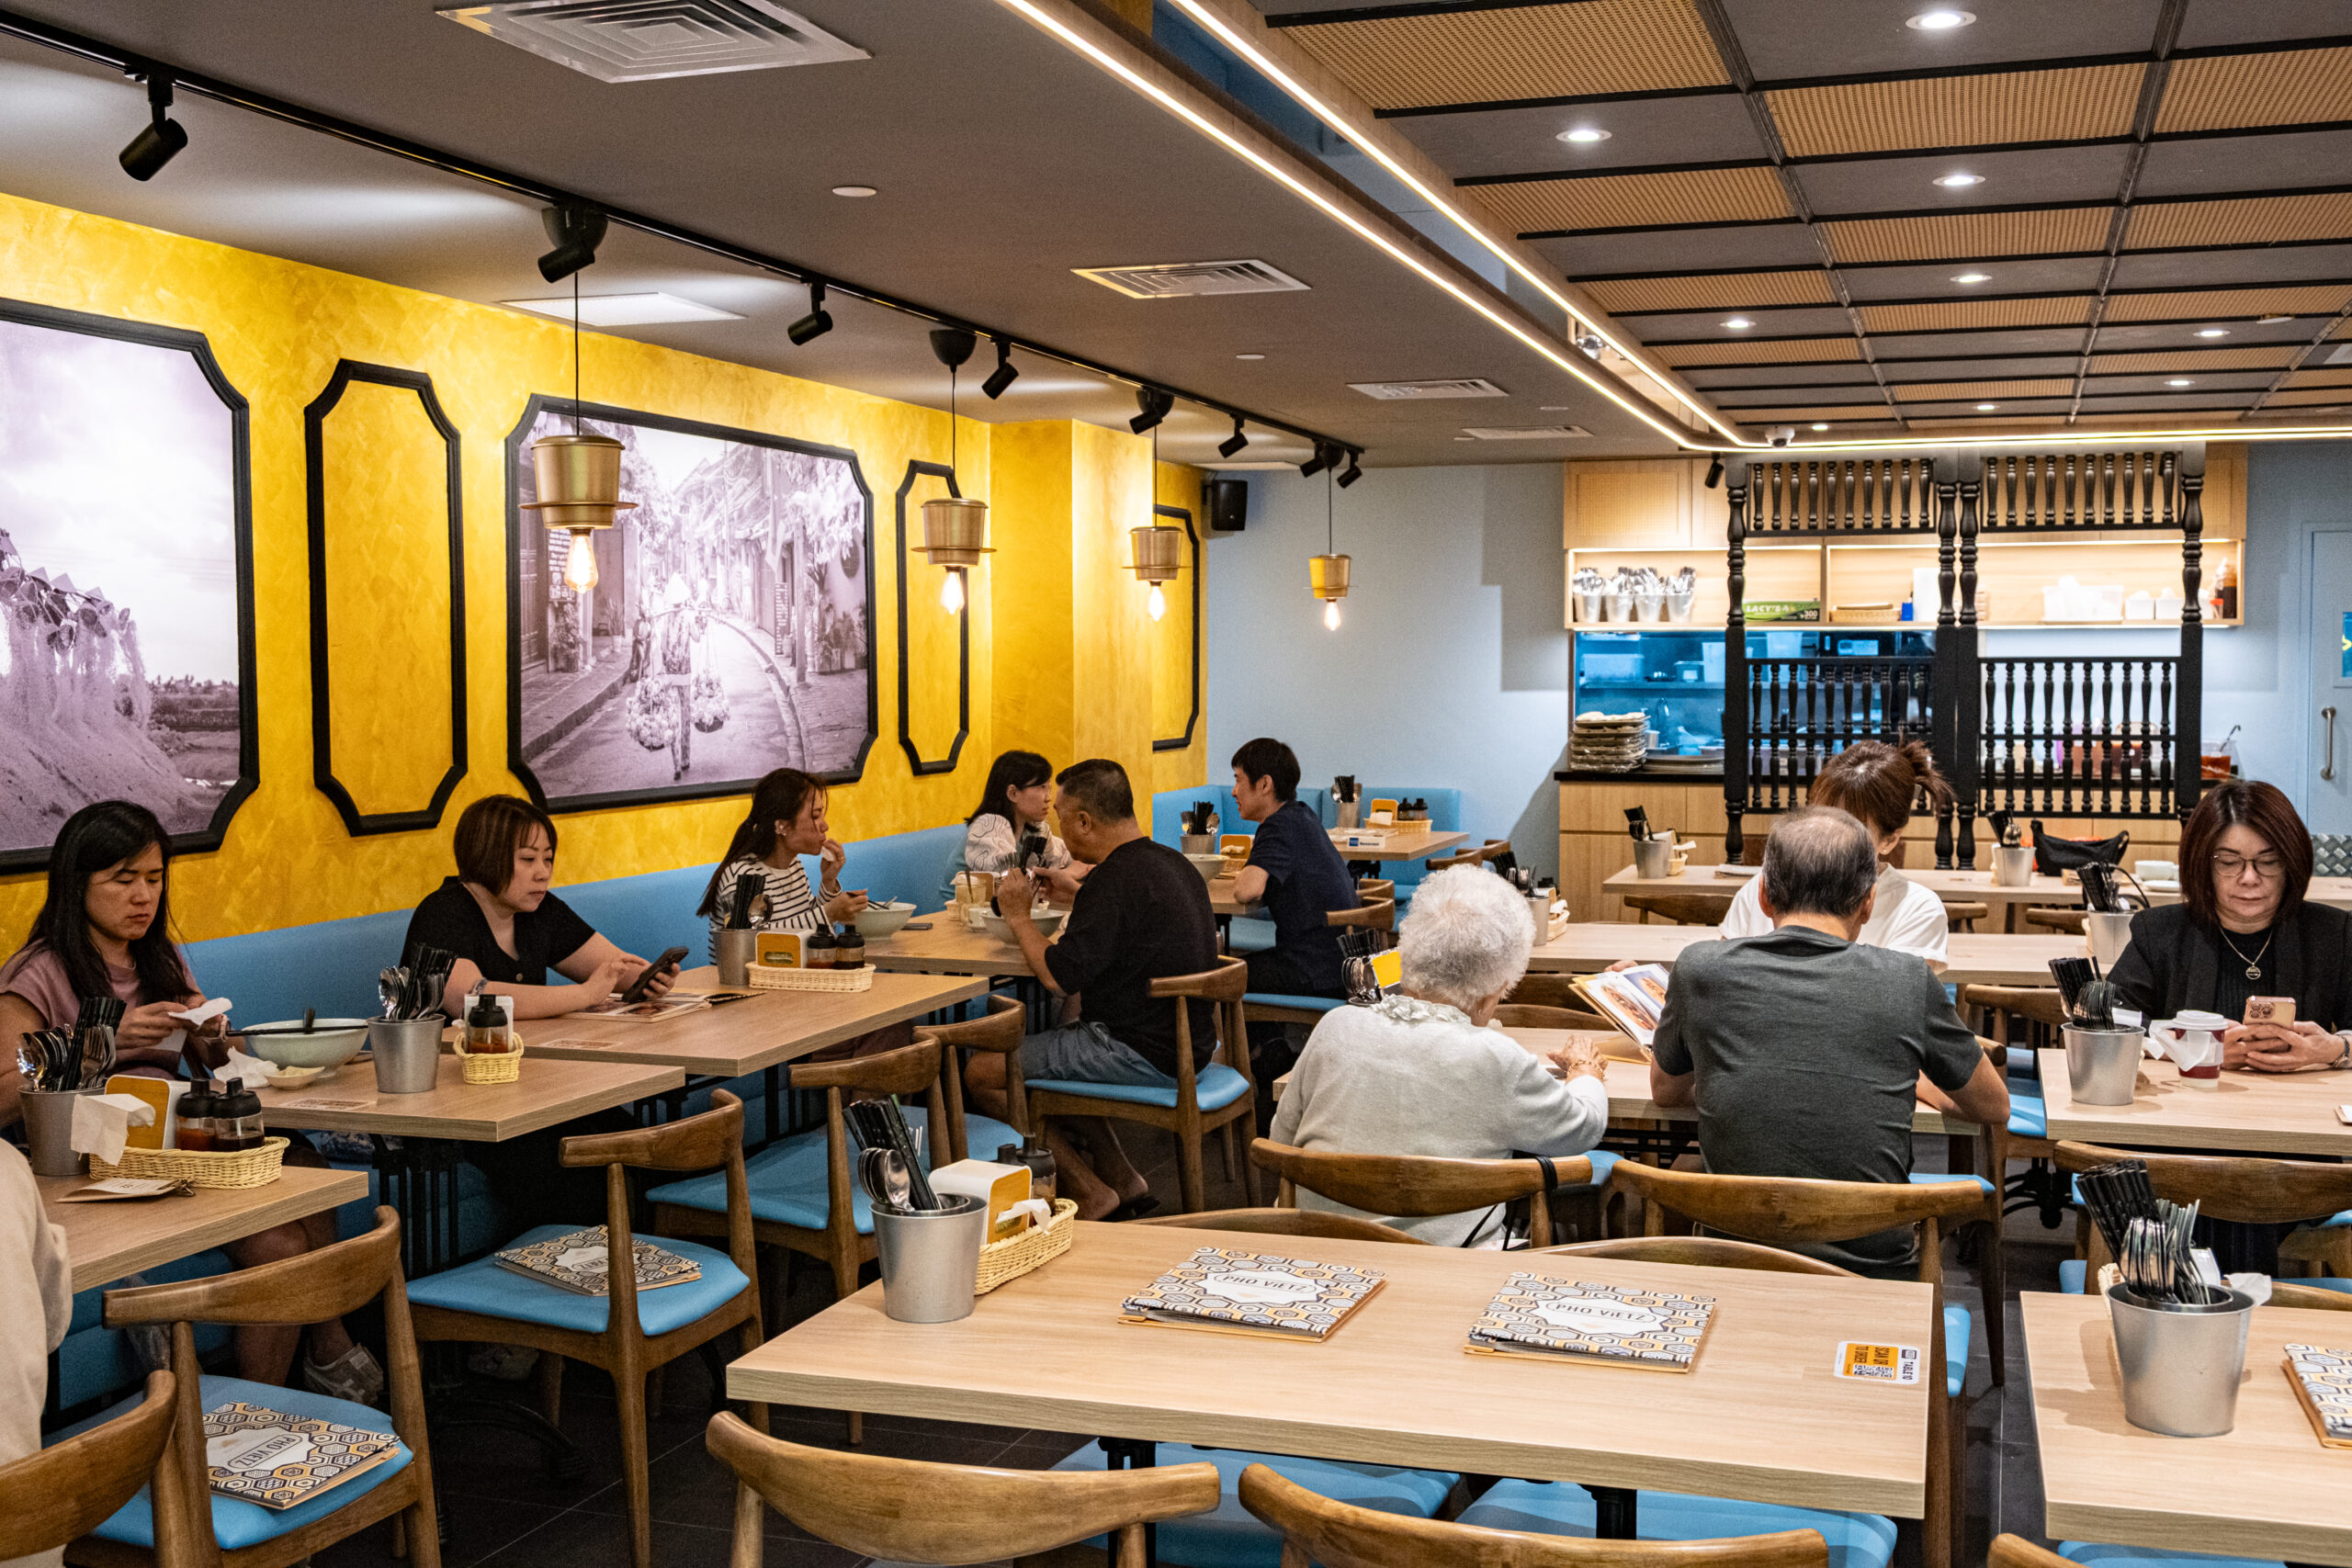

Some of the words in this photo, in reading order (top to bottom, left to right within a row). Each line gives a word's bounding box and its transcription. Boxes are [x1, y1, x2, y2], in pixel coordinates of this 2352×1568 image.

[1746, 604, 1781, 613] LACY'S
[1223, 1275, 1258, 1285] PHO
[1555, 1303, 1592, 1314] PHO
[1874, 1347, 1890, 1359] SCAN
[266, 1437, 296, 1450] PHO
